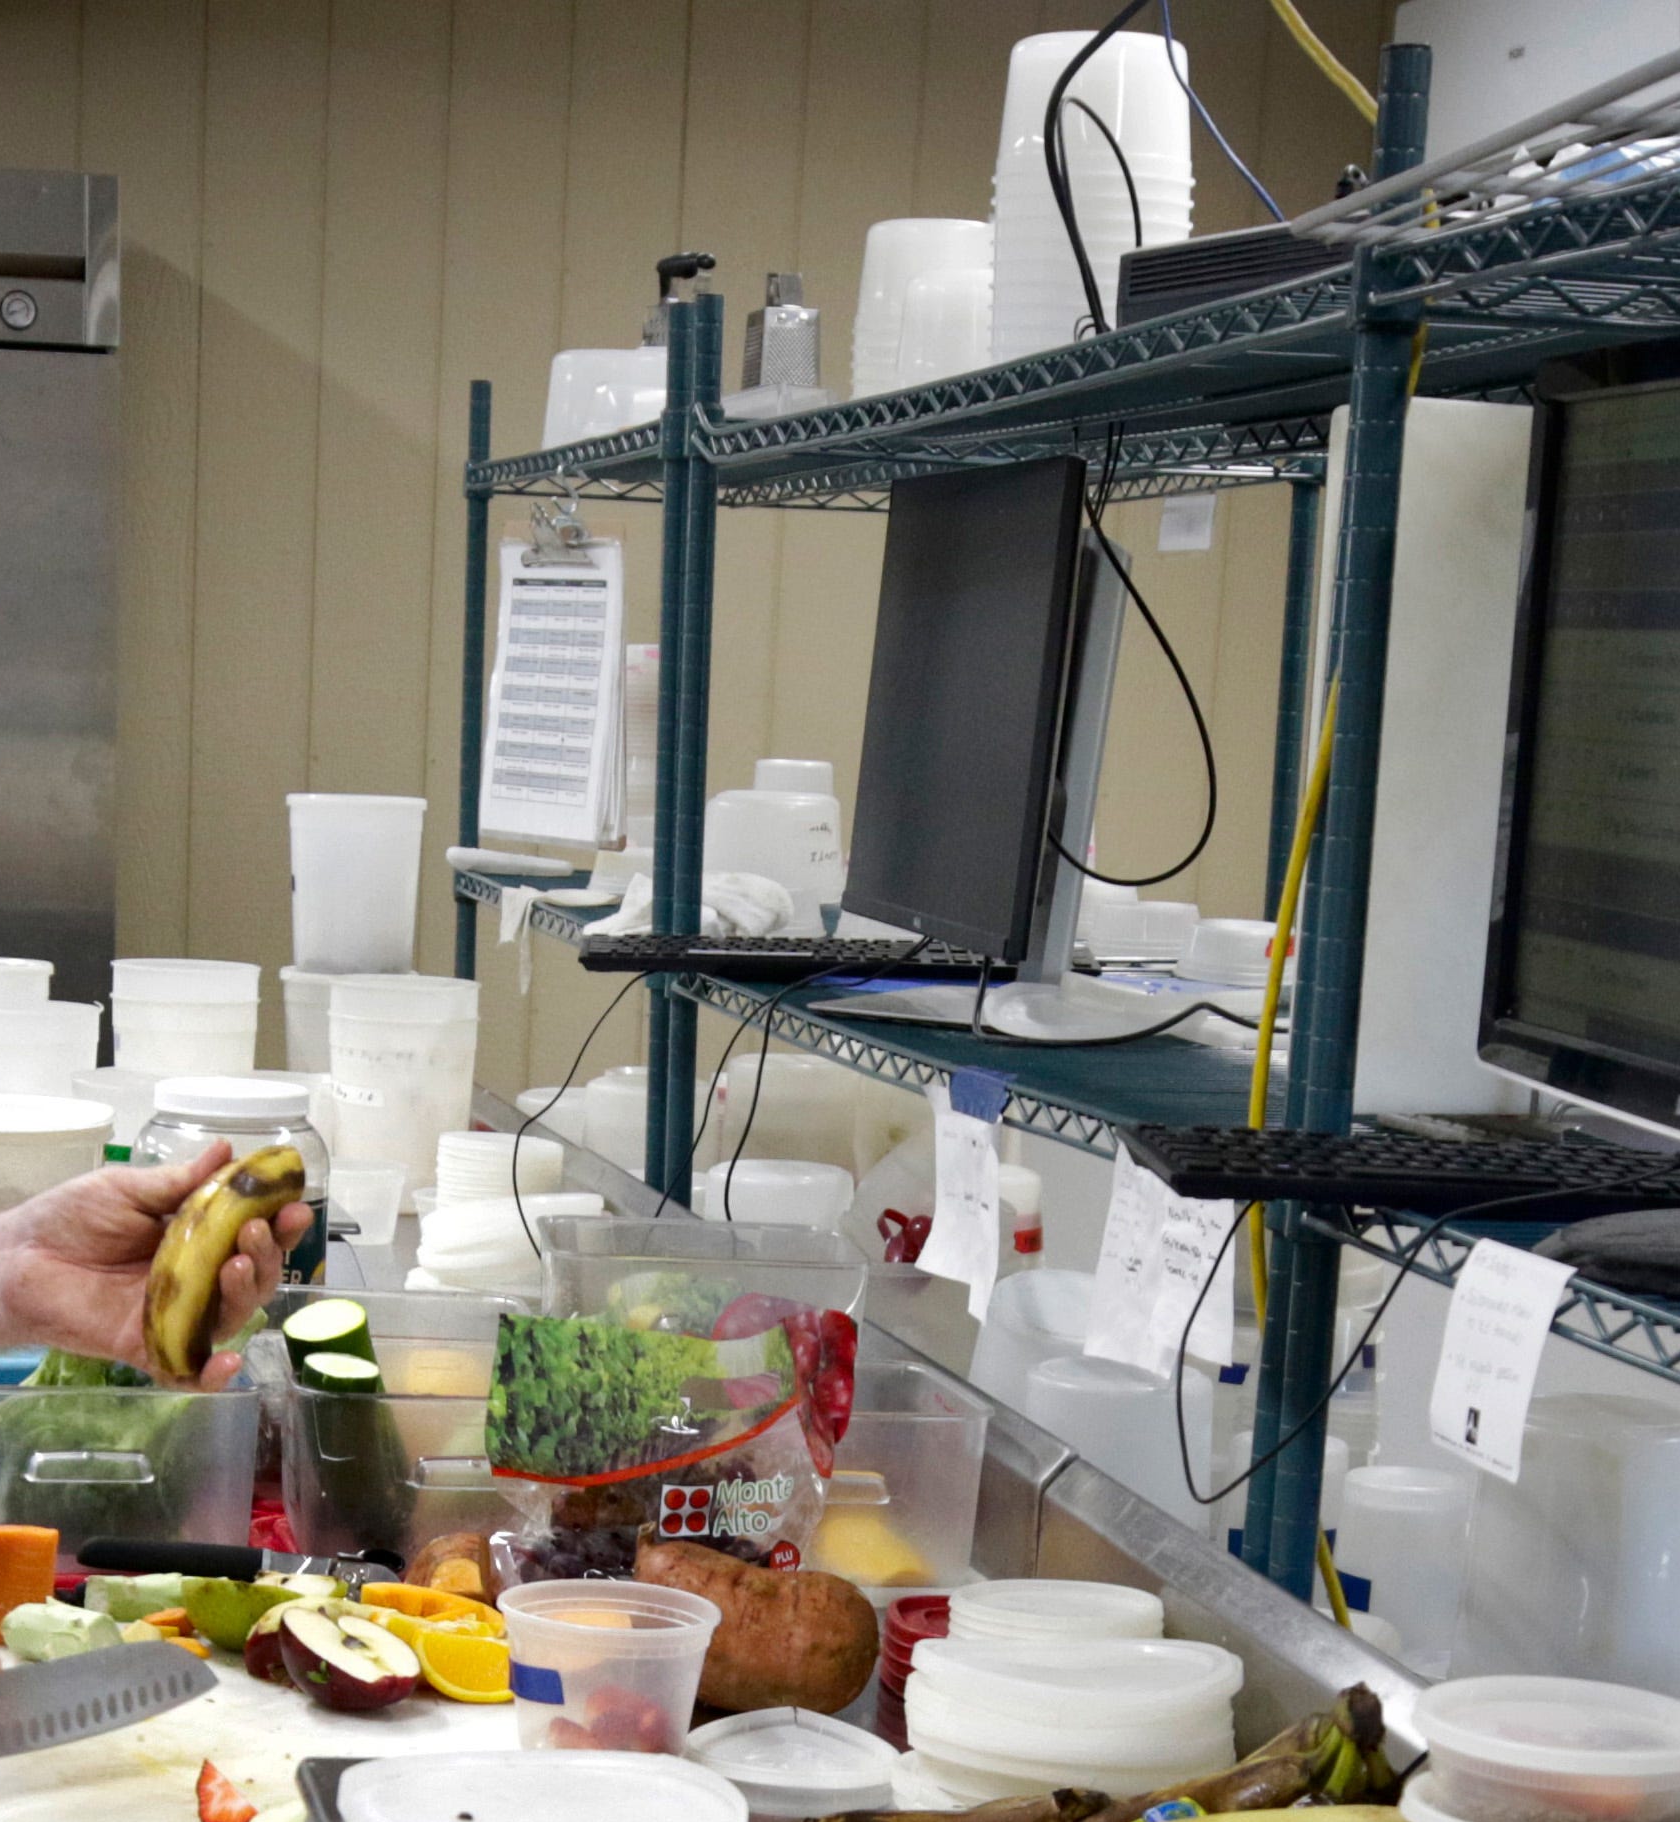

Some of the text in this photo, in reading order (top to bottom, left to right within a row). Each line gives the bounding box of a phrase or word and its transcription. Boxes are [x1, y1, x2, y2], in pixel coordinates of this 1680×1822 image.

[715, 1477, 795, 1507] Monte
[712, 1508, 771, 1538] Alto
[774, 1550, 793, 1565] PLU
